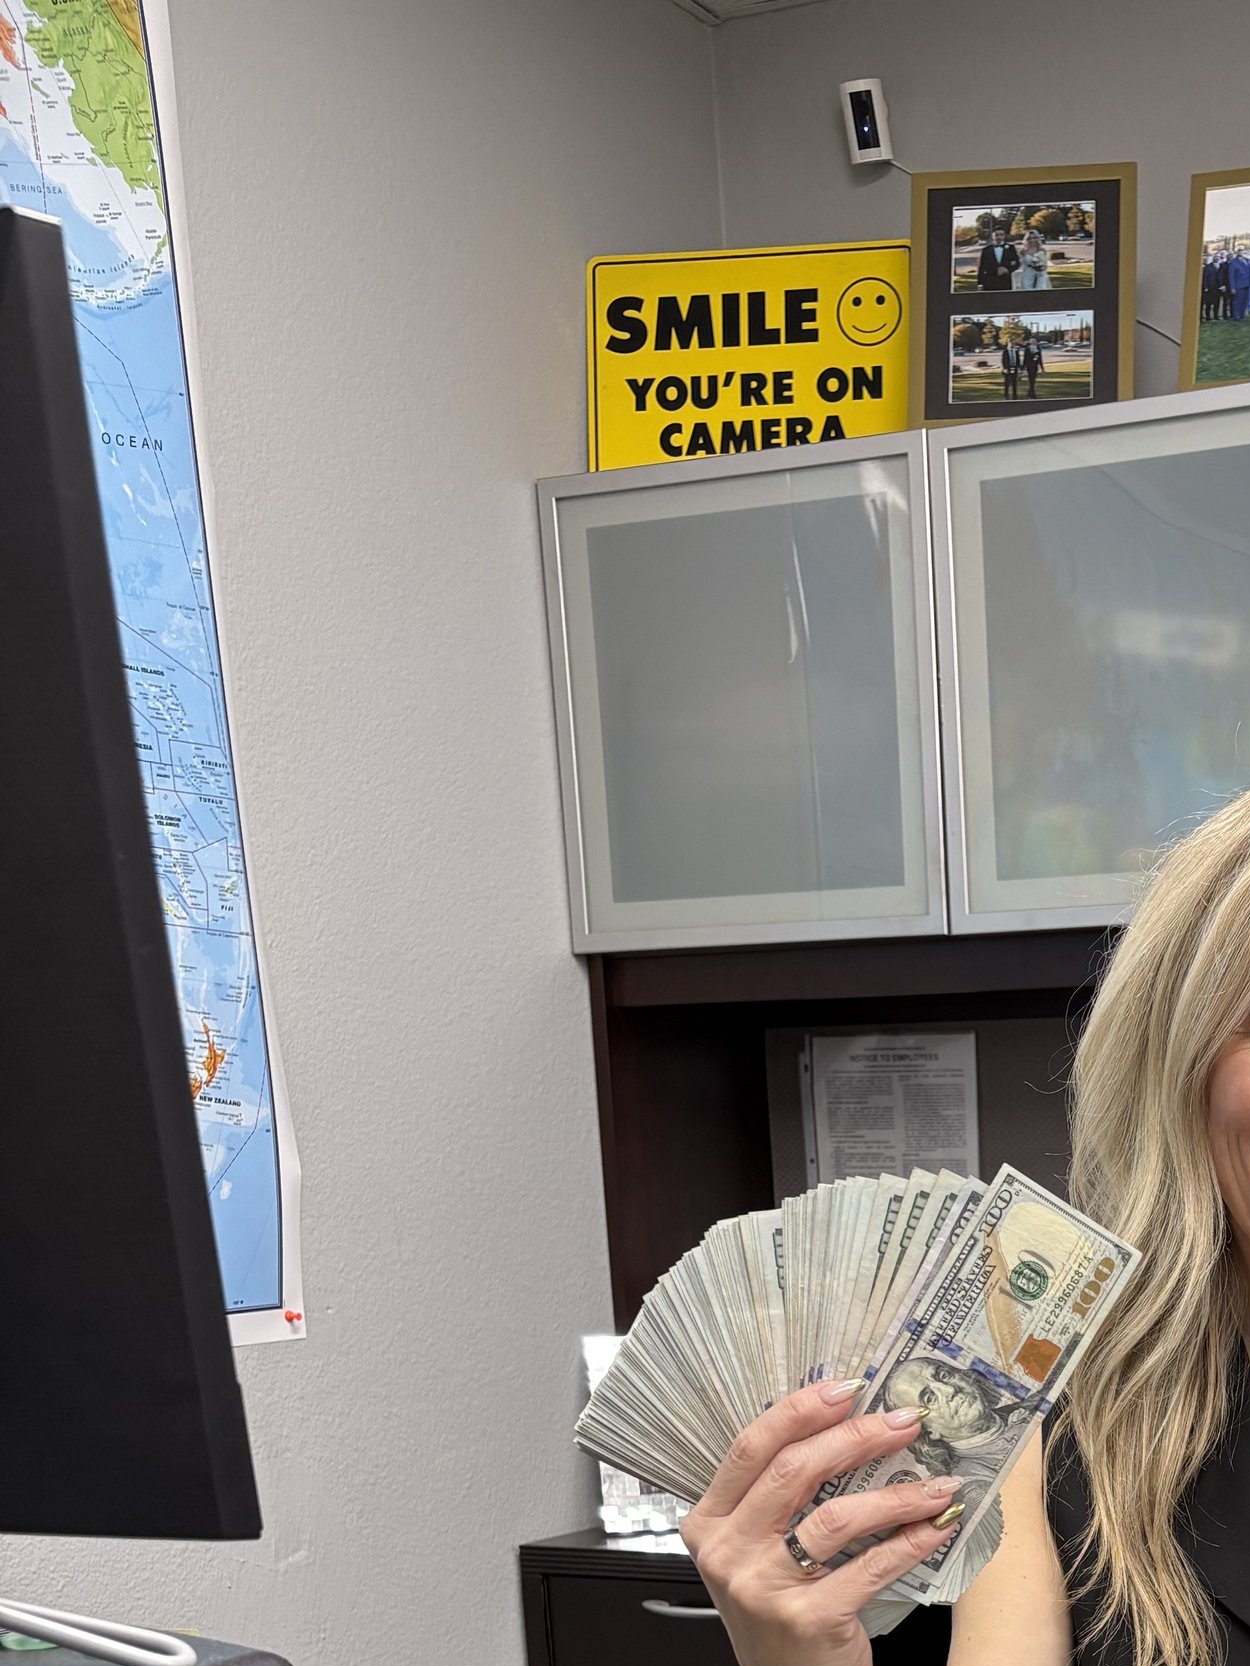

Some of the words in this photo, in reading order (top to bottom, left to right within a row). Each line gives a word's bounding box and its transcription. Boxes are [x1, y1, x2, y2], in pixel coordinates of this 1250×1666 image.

[605, 287, 819, 354] SMILE
[625, 370, 794, 412] YOU'RE
[816, 365, 883, 403] ON
[101, 432, 163, 451] OCEAN
[659, 415, 846, 458] CAMERA
[214, 1096, 241, 1107] ZEALAND
[979, 1189, 1013, 1237] 100
[1072, 1257, 1115, 1319] 100
